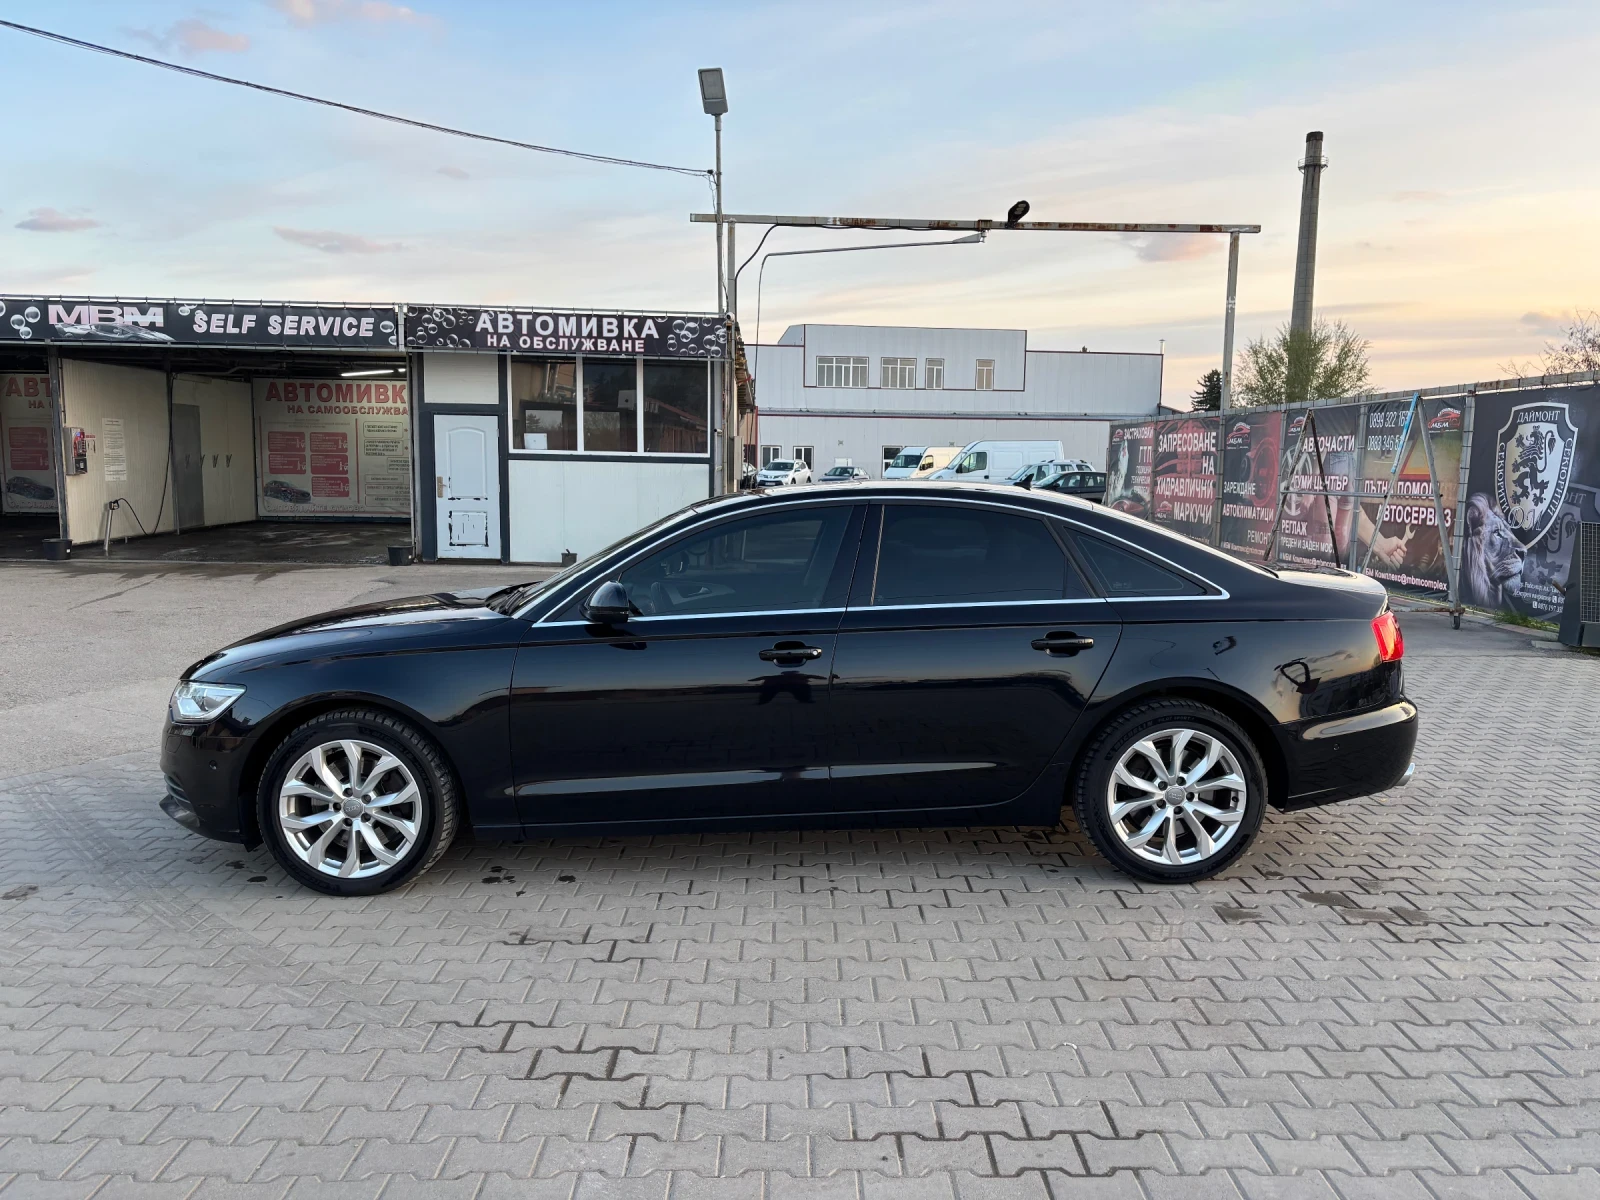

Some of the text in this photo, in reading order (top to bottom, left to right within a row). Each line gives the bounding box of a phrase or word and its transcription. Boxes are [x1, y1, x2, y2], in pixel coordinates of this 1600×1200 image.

[48, 304, 164, 327] MBM
[193, 313, 375, 337] SELF SERVICE
[475, 312, 660, 338] АВТОМИВКА
[487, 335, 645, 352] НА ОБСЛУЖВАНЕ
[266, 382, 407, 404] АВТОМИВК
[28, 400, 45, 408] НА
[287, 405, 304, 414] НА
[1516, 410, 1560, 423] ДАЙМОНТ
[1158, 432, 1216, 452] ЗАПРЕСОВАНЕ
[1202, 456, 1214, 474] НА
[1498, 442, 1510, 513] СЕКЮРИТИ
[1547, 438, 1573, 516] СЕКЮРИТИ
[1156, 477, 1213, 498] ХИДРАВЛИЧНИ
[1224, 482, 1256, 496] ЗАРЕЖДАНЕ
[1364, 480, 1394, 494] ПЪТН
[1174, 502, 1212, 524] МАРКУЧИ
[1222, 504, 1274, 523] АВТОКЛИМАТИЦИ
[1282, 520, 1308, 536] РЕГЛАЖ
[1302, 540, 1320, 552] ЗАДЕН
